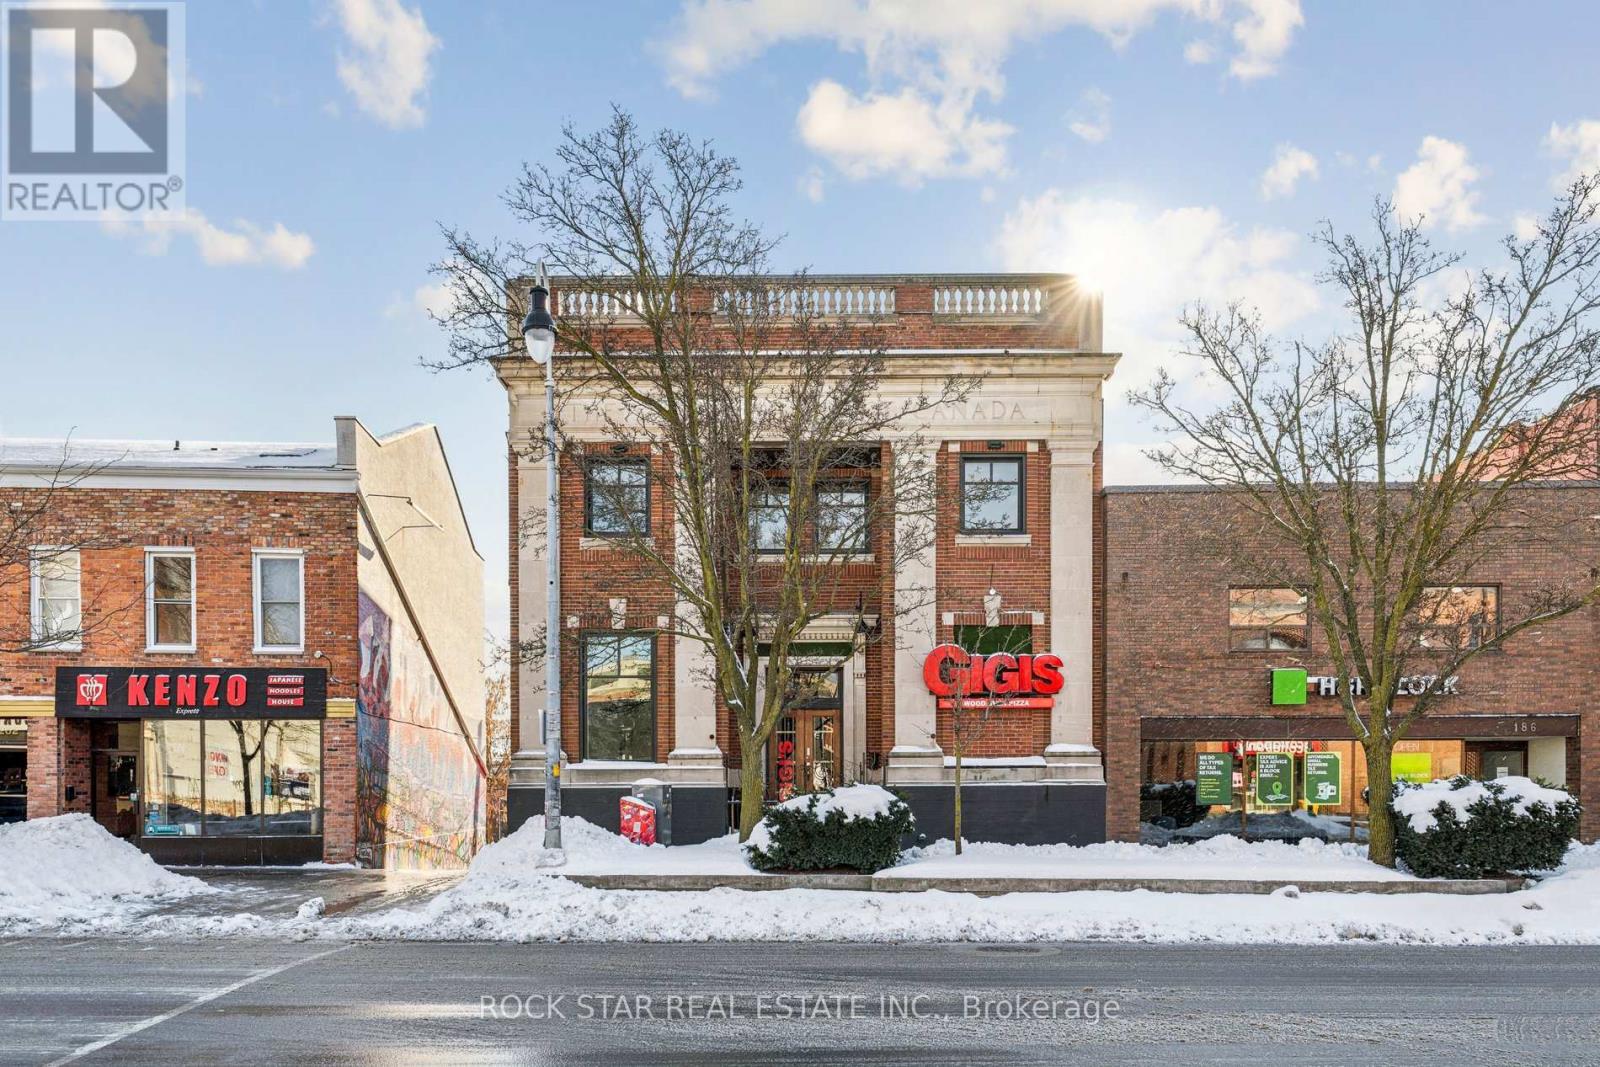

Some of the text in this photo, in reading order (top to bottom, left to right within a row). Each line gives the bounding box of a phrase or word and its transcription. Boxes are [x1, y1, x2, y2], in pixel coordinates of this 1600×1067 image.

[923, 643, 1065, 696] GIGIS
[127, 673, 247, 706] KENZO
[1513, 721, 1537, 732] 186
